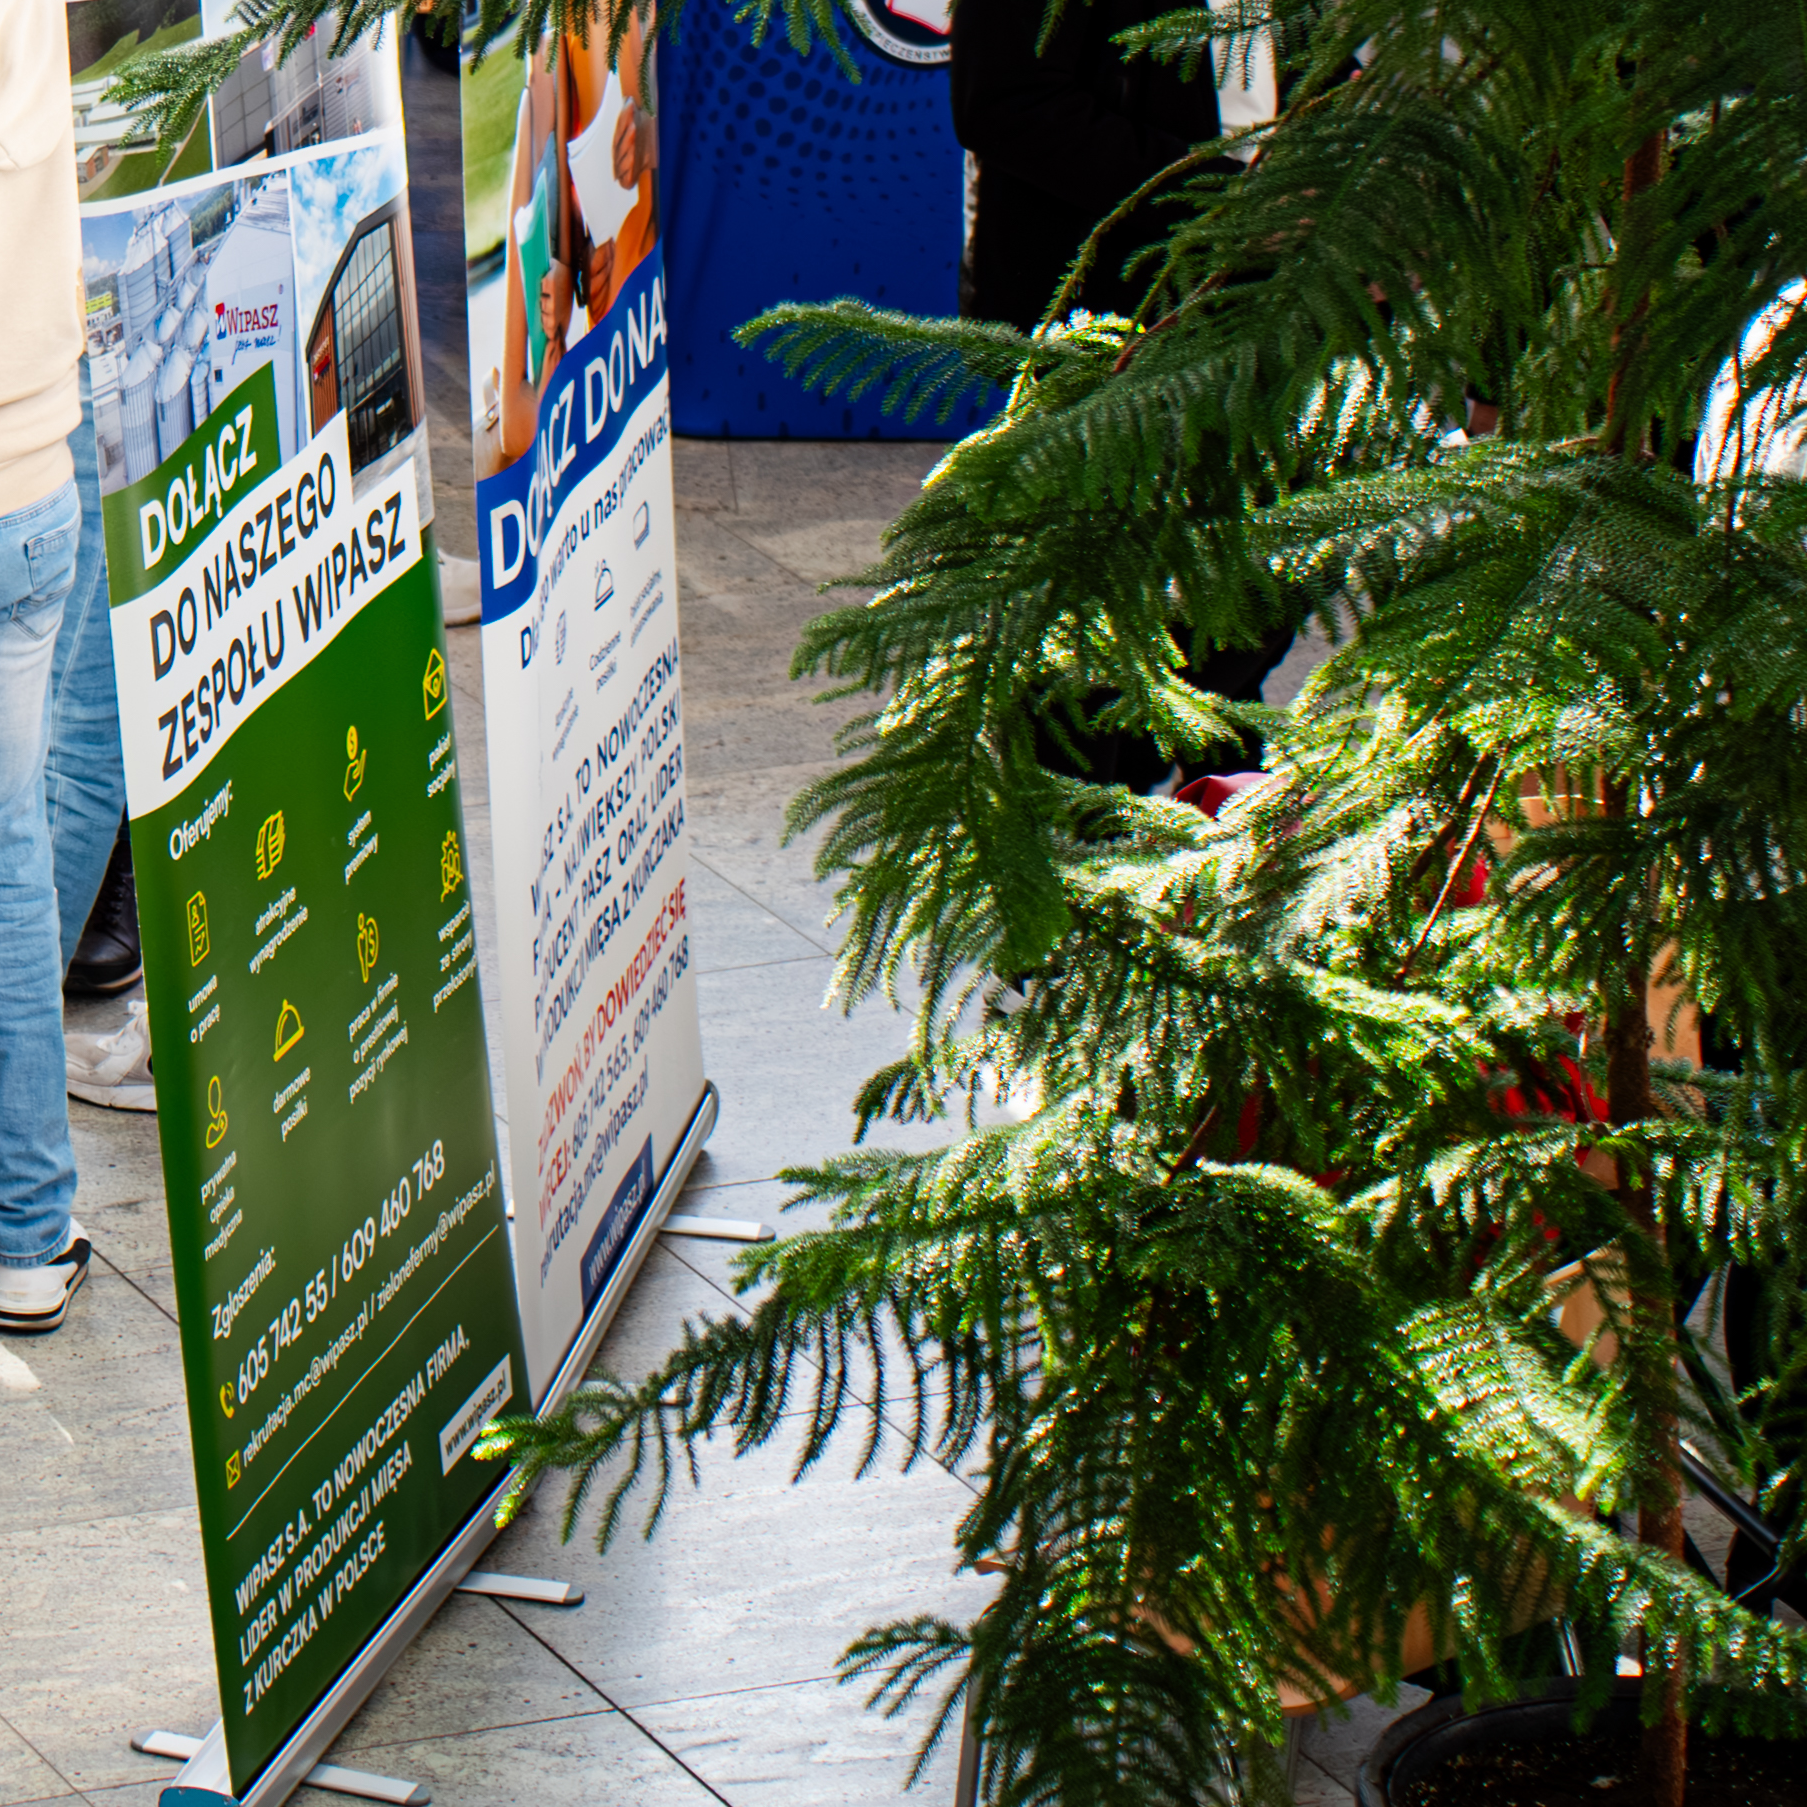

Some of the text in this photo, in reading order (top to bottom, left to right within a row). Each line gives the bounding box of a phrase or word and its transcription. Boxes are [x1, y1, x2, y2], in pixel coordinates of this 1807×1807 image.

[226, 303, 279, 336] WIPASZ
[139, 403, 258, 571] DOŁĄCZ
[594, 481, 618, 529] nas
[149, 452, 336, 683] DO NASZEGO
[157, 598, 286, 782] ZESPOŁU
[292, 490, 406, 644] WIPASZ
[575, 757, 592, 805] TO
[596, 636, 679, 778] NOWOCZESNA
[169, 779, 234, 861] Oferujemy:
[563, 753, 638, 895] NAJWIĘKSZY
[641, 687, 681, 775] POLSKI
[581, 845, 612, 918] PASZ
[617, 793, 648, 867] ORAZ
[650, 743, 683, 816] LIDER
[344, 833, 379, 885] premiowy
[585, 895, 622, 972] MIĘSA
[622, 881, 631, 921] Z
[629, 796, 685, 909] KURCZAKA
[248, 905, 309, 975] wynagrodzenie
[255, 887, 296, 936] atrakcyjne
[188, 975, 218, 1014] umowa
[439, 953, 451, 972] ze
[596, 892, 669, 1034] DOWIEDZIEĆ
[667, 878, 688, 935] SIĘ
[190, 1003, 221, 1043] o pracę
[349, 1007, 371, 1042] praca
[377, 972, 399, 1004] firmie
[572, 1100, 588, 1160] 605
[606, 1034, 634, 1095] 565,
[633, 999, 652, 1057] 609
[651, 964, 669, 1023] 460
[668, 934, 690, 983] 768
[273, 1066, 312, 1114] darmowe
[349, 1021, 409, 1104] pozycji rynkowej
[352, 1049, 361, 1064] o
[280, 1095, 309, 1142] posiłki
[200, 1150, 238, 1205] prywatna
[209, 1185, 236, 1224] opieka
[203, 1208, 244, 1262] medyczna
[237, 1335, 269, 1405] 605
[269, 1298, 303, 1362] 742
[304, 1268, 328, 1323] 55
[341, 1217, 377, 1283] 609
[379, 1177, 412, 1239] 460
[412, 1139, 446, 1201] 768
[211, 1246, 277, 1340] Zgłoszenia:
[243, 1300, 370, 1468] rekrutacja.mc@wipasz.pl
[376, 1159, 496, 1313] zielonefermy@wipasz.pl
[445, 1369, 507, 1457] www.wipasz.pl
[235, 1323, 471, 1616] WIPASZ S.A. TO NOWOCZESNA FIRMA,
[239, 1440, 413, 1667] LIDER W PRODUKCJI MIĘSA
[243, 1519, 386, 1716] Z KURCZKA W POLSCE
